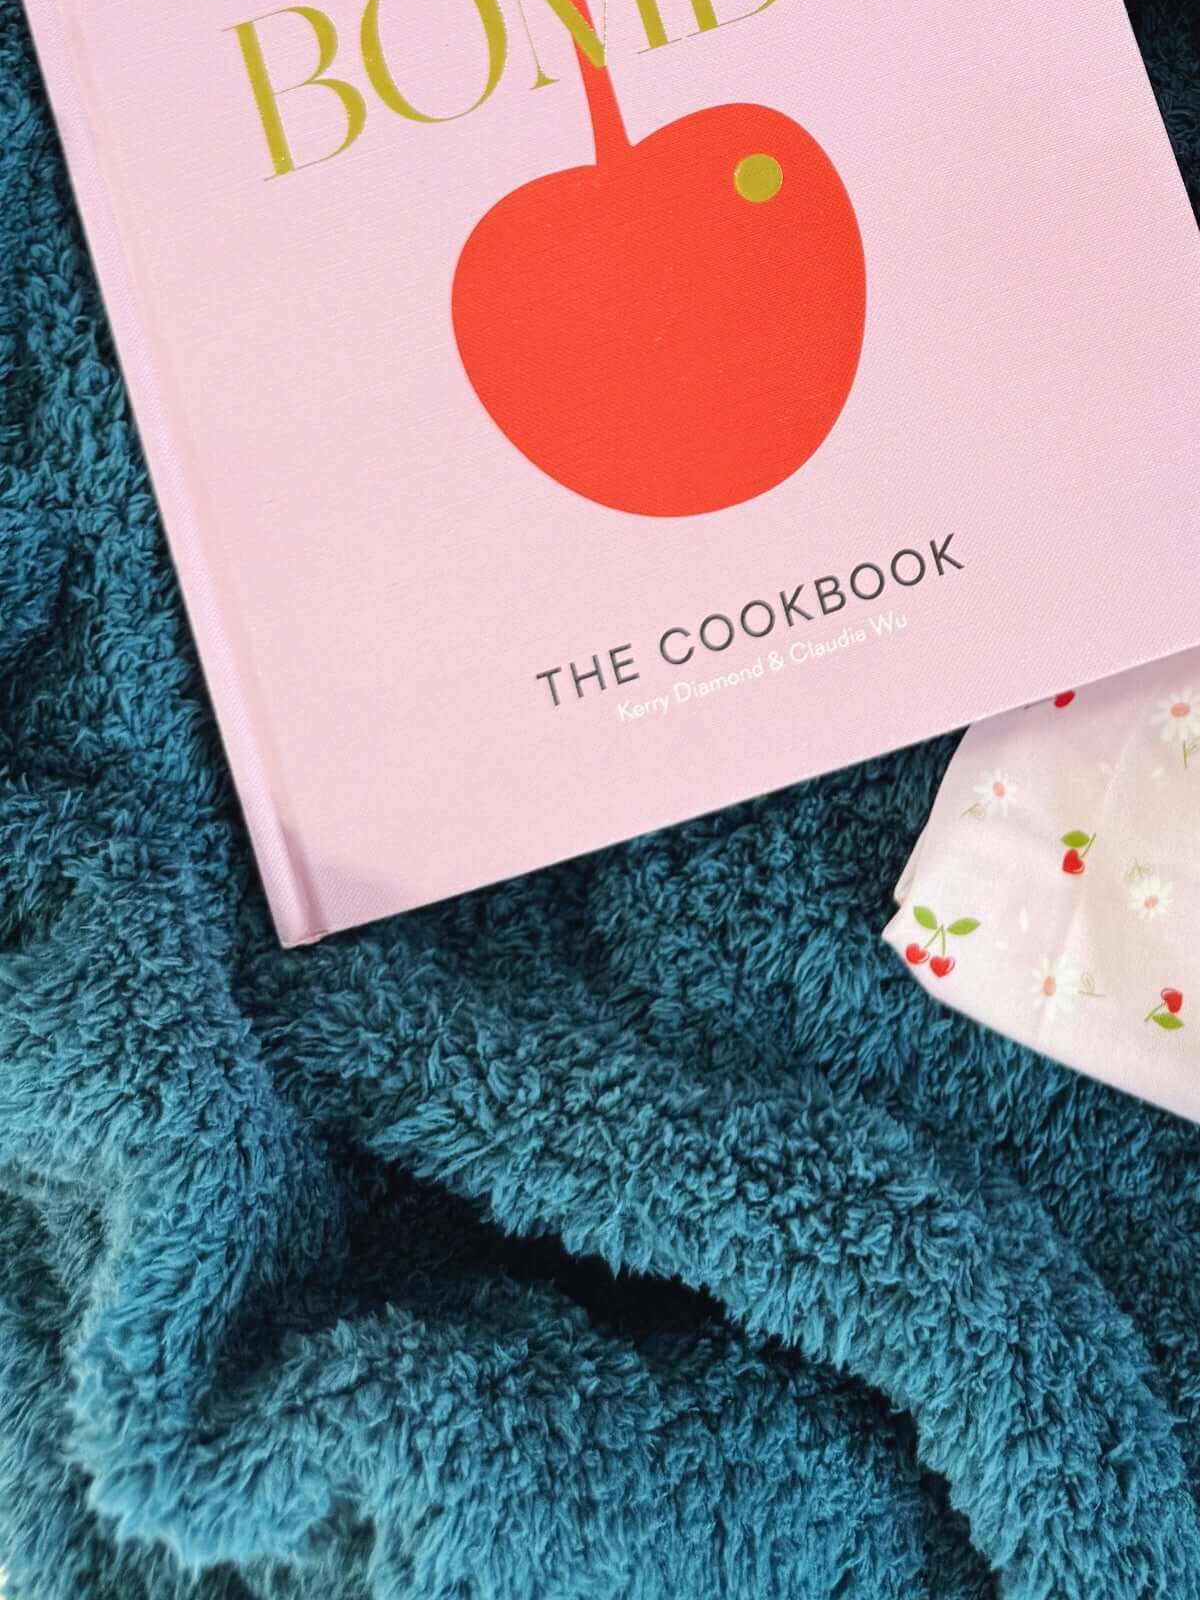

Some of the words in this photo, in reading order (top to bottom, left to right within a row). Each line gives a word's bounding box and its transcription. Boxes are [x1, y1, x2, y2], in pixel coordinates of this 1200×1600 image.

[535, 643, 641, 707] THE
[658, 532, 966, 666] COOKBOOK
[616, 690, 671, 722] Kerry
[673, 657, 765, 705] Diamond
[767, 650, 785, 672] &
[788, 627, 868, 666] Claudia
[869, 610, 909, 636] Wu
